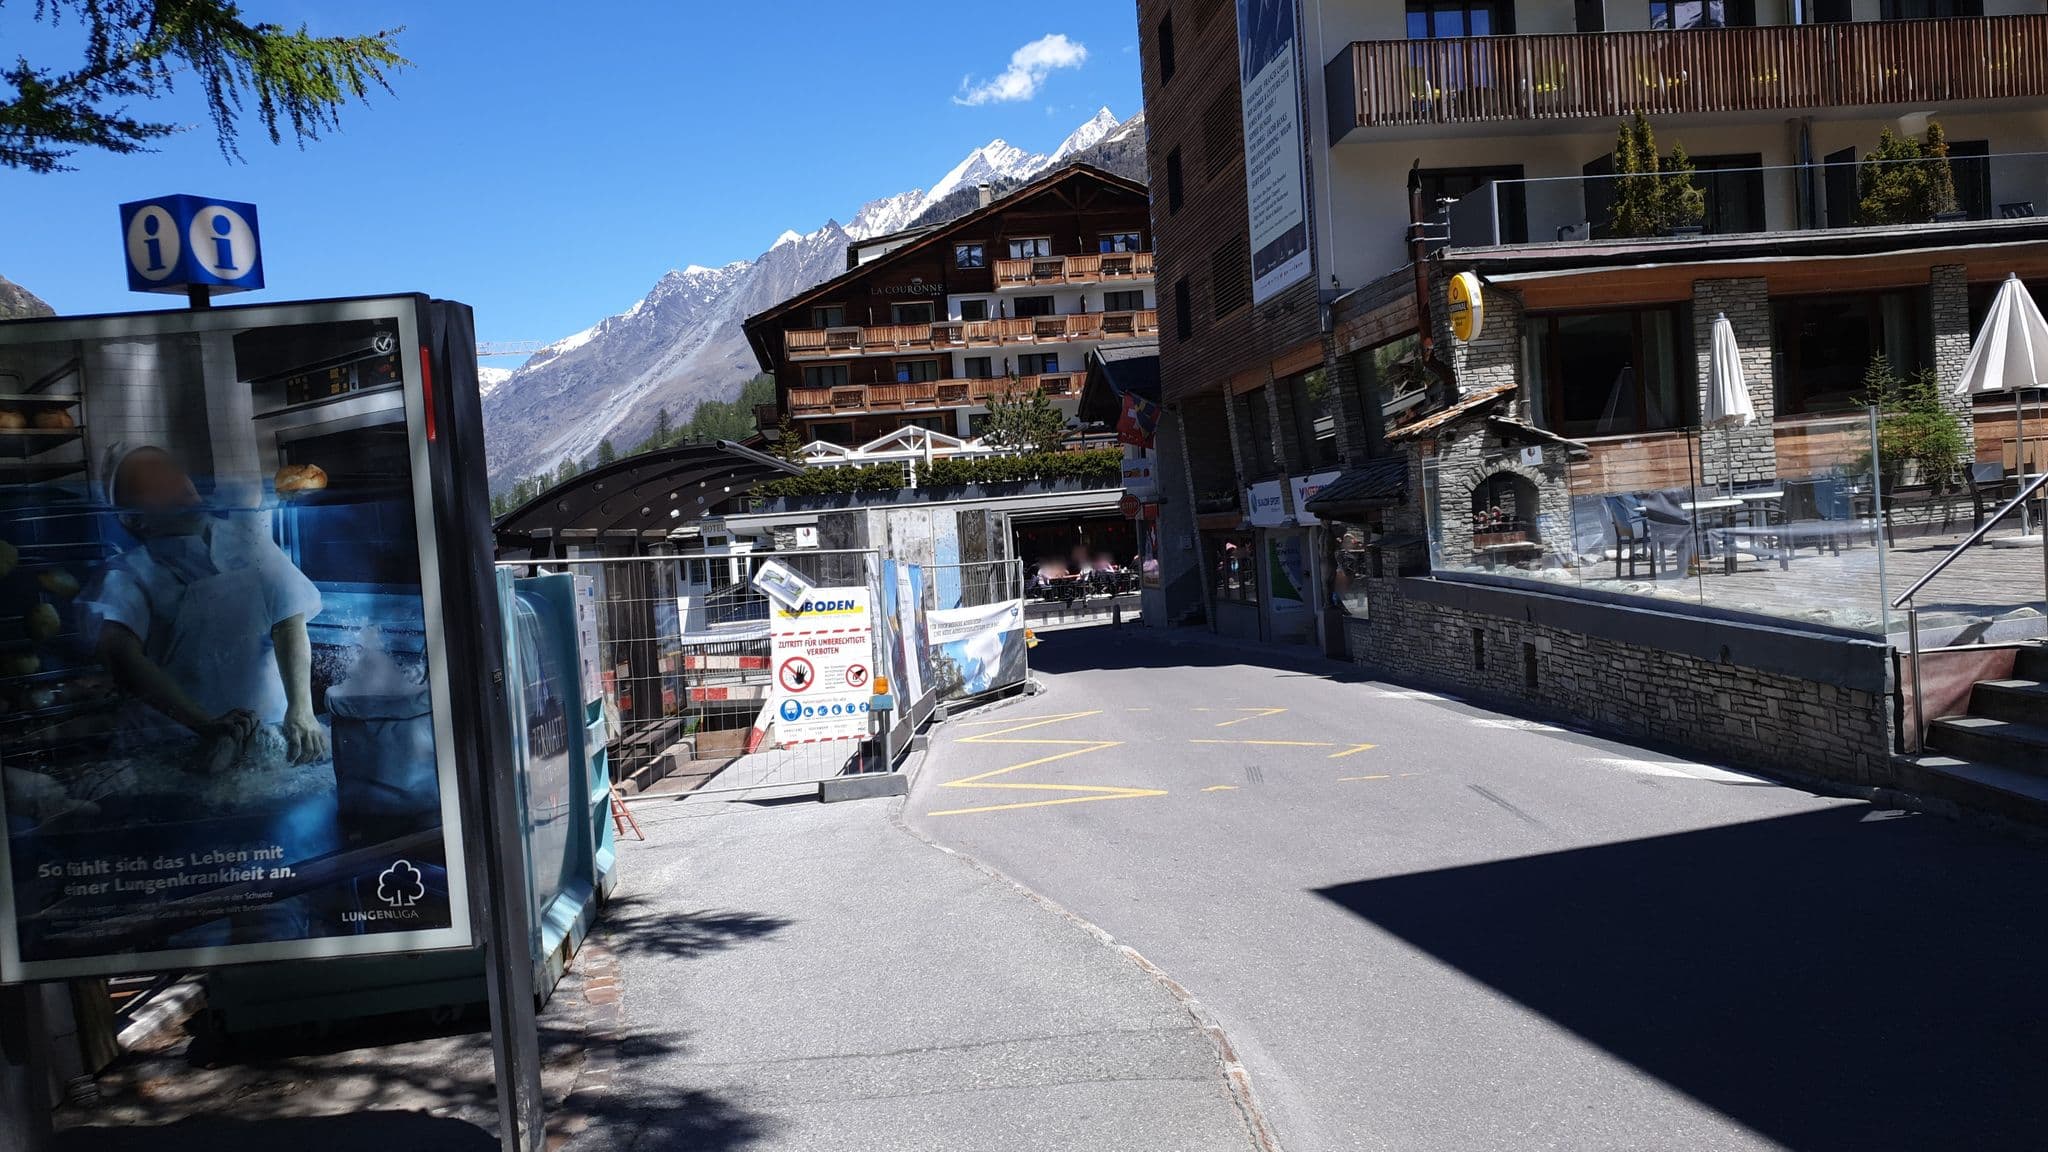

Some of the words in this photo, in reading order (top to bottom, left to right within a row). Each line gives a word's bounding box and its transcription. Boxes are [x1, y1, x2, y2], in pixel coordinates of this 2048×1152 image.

[871, 287, 882, 295] LA
[885, 284, 944, 295] COURONNE
[703, 523, 725, 533] HOTEL
[787, 599, 855, 613] BODEN
[778, 640, 803, 649] ZUTRITT
[805, 637, 817, 647] FÜR
[818, 636, 866, 646] UNBERECHTIGTE
[806, 647, 839, 656] VERBOTEN
[38, 863, 62, 879] So
[66, 859, 110, 876] fühlt
[115, 857, 148, 873] sich
[153, 854, 184, 870] das
[190, 848, 247, 866] Leben
[253, 845, 283, 860] mit
[64, 881, 109, 897] einer
[114, 866, 264, 894] Lungenkrankheit
[269, 864, 296, 880] an.
[244, 890, 274, 899] Schweiz
[341, 909, 420, 922] LUNGENLIGA
